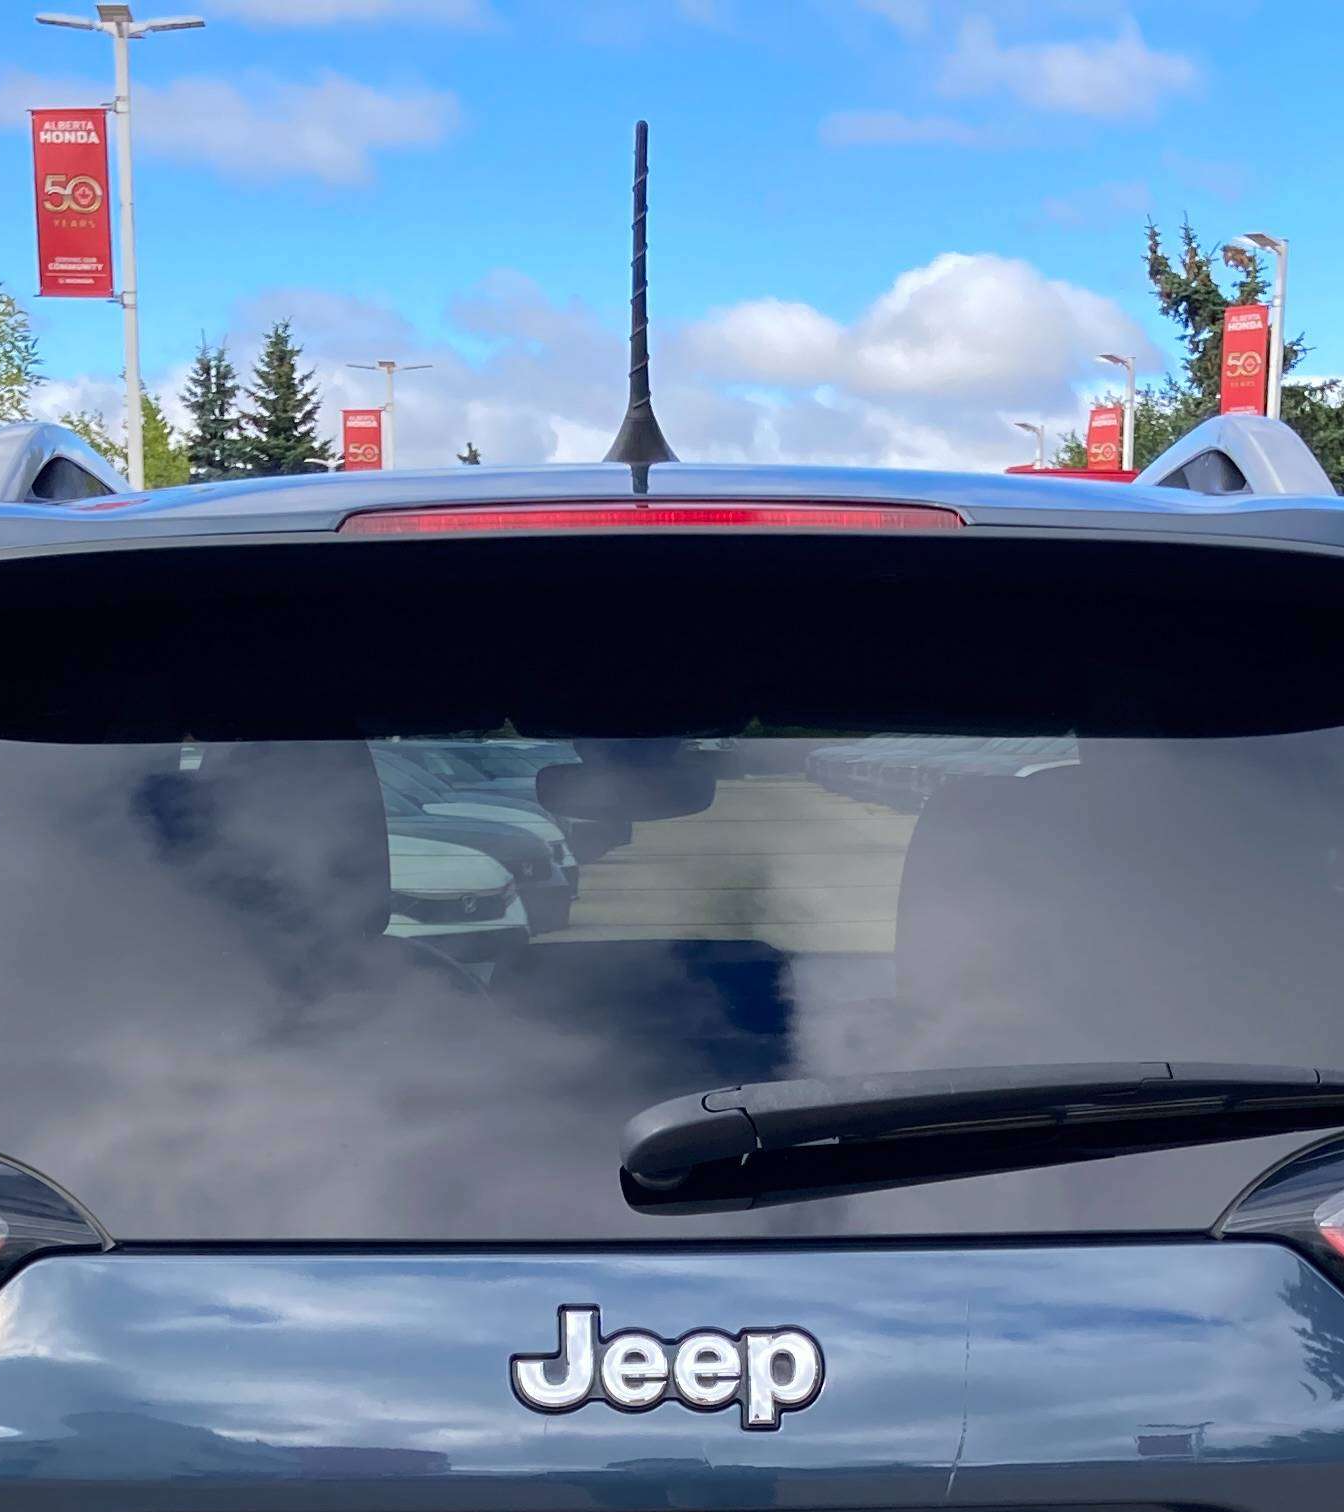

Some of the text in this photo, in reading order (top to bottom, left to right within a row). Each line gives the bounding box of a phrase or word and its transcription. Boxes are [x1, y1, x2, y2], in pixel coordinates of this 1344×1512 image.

[42, 121, 95, 130] ALBERTA
[39, 131, 100, 144] HONDA
[43, 174, 103, 214] 50
[1227, 321, 1263, 332] HONDA
[1226, 351, 1262, 377] 50
[348, 443, 379, 462] 50
[1090, 442, 1117, 462] 50
[512, 1306, 822, 1429] Jeep
